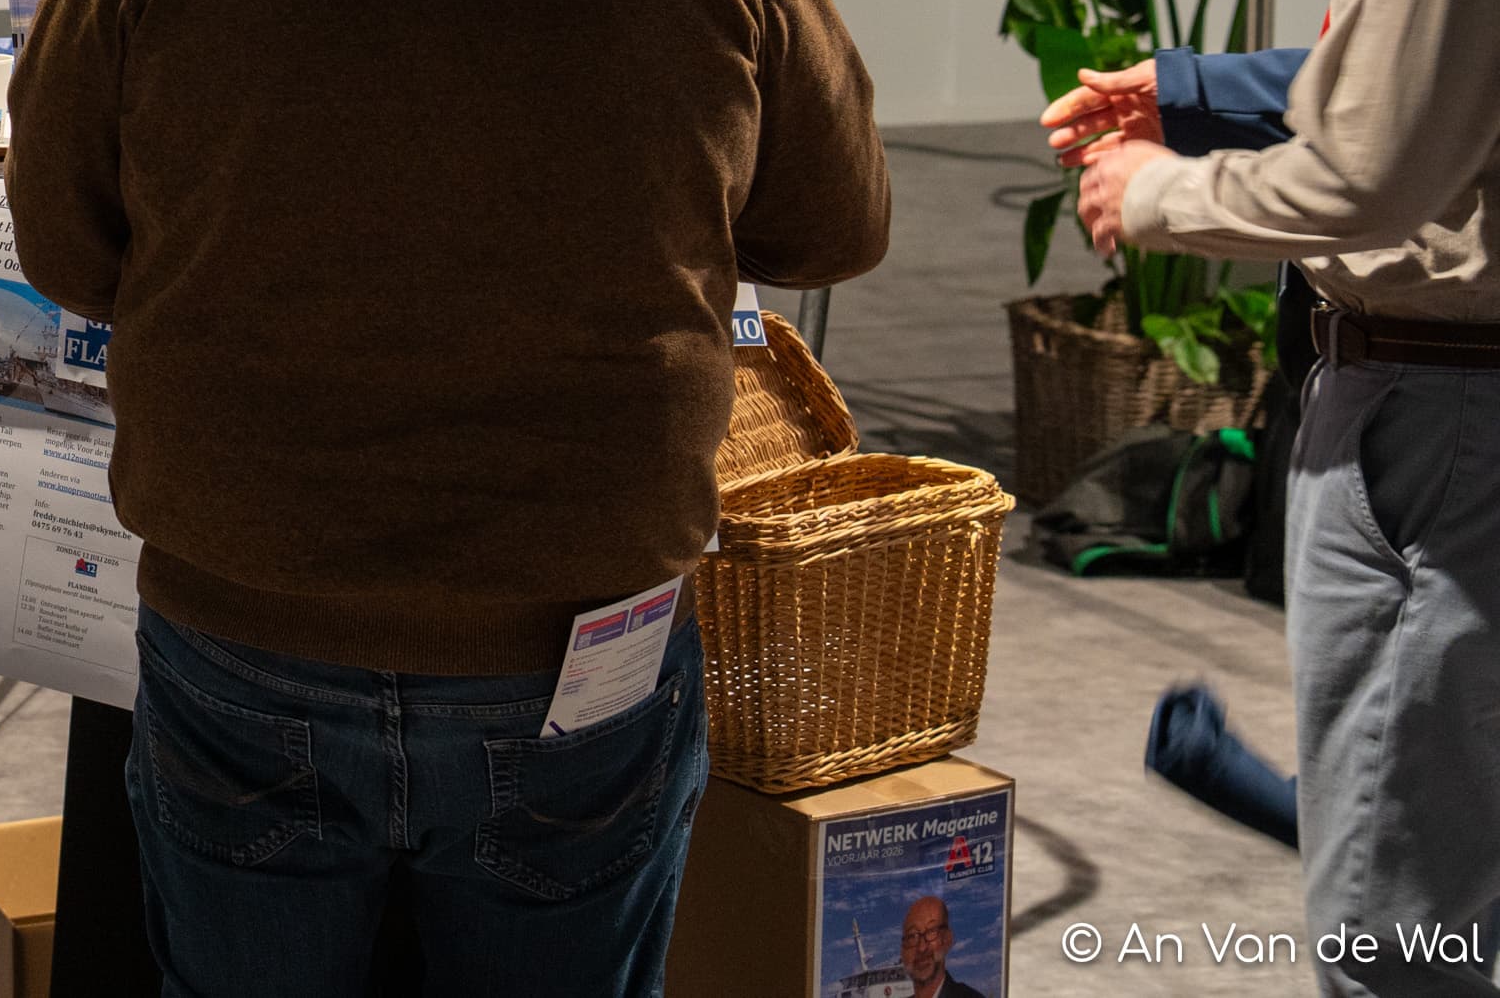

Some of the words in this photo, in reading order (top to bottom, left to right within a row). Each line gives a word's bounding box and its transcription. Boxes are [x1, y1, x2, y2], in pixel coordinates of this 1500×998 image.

[78, 444, 93, 454] Voor
[95, 448, 103, 457] de
[40, 468, 69, 481] Anderen
[70, 476, 80, 484] via
[32, 520, 50, 531] 0475
[52, 525, 61, 533] 69
[63, 527, 72, 536] 76
[56, 546, 81, 557] ZONDAG
[827, 824, 918, 854] NETWERK
[921, 809, 998, 838] Magazine
[944, 836, 994, 872] A12
[978, 865, 993, 874] CLUB
